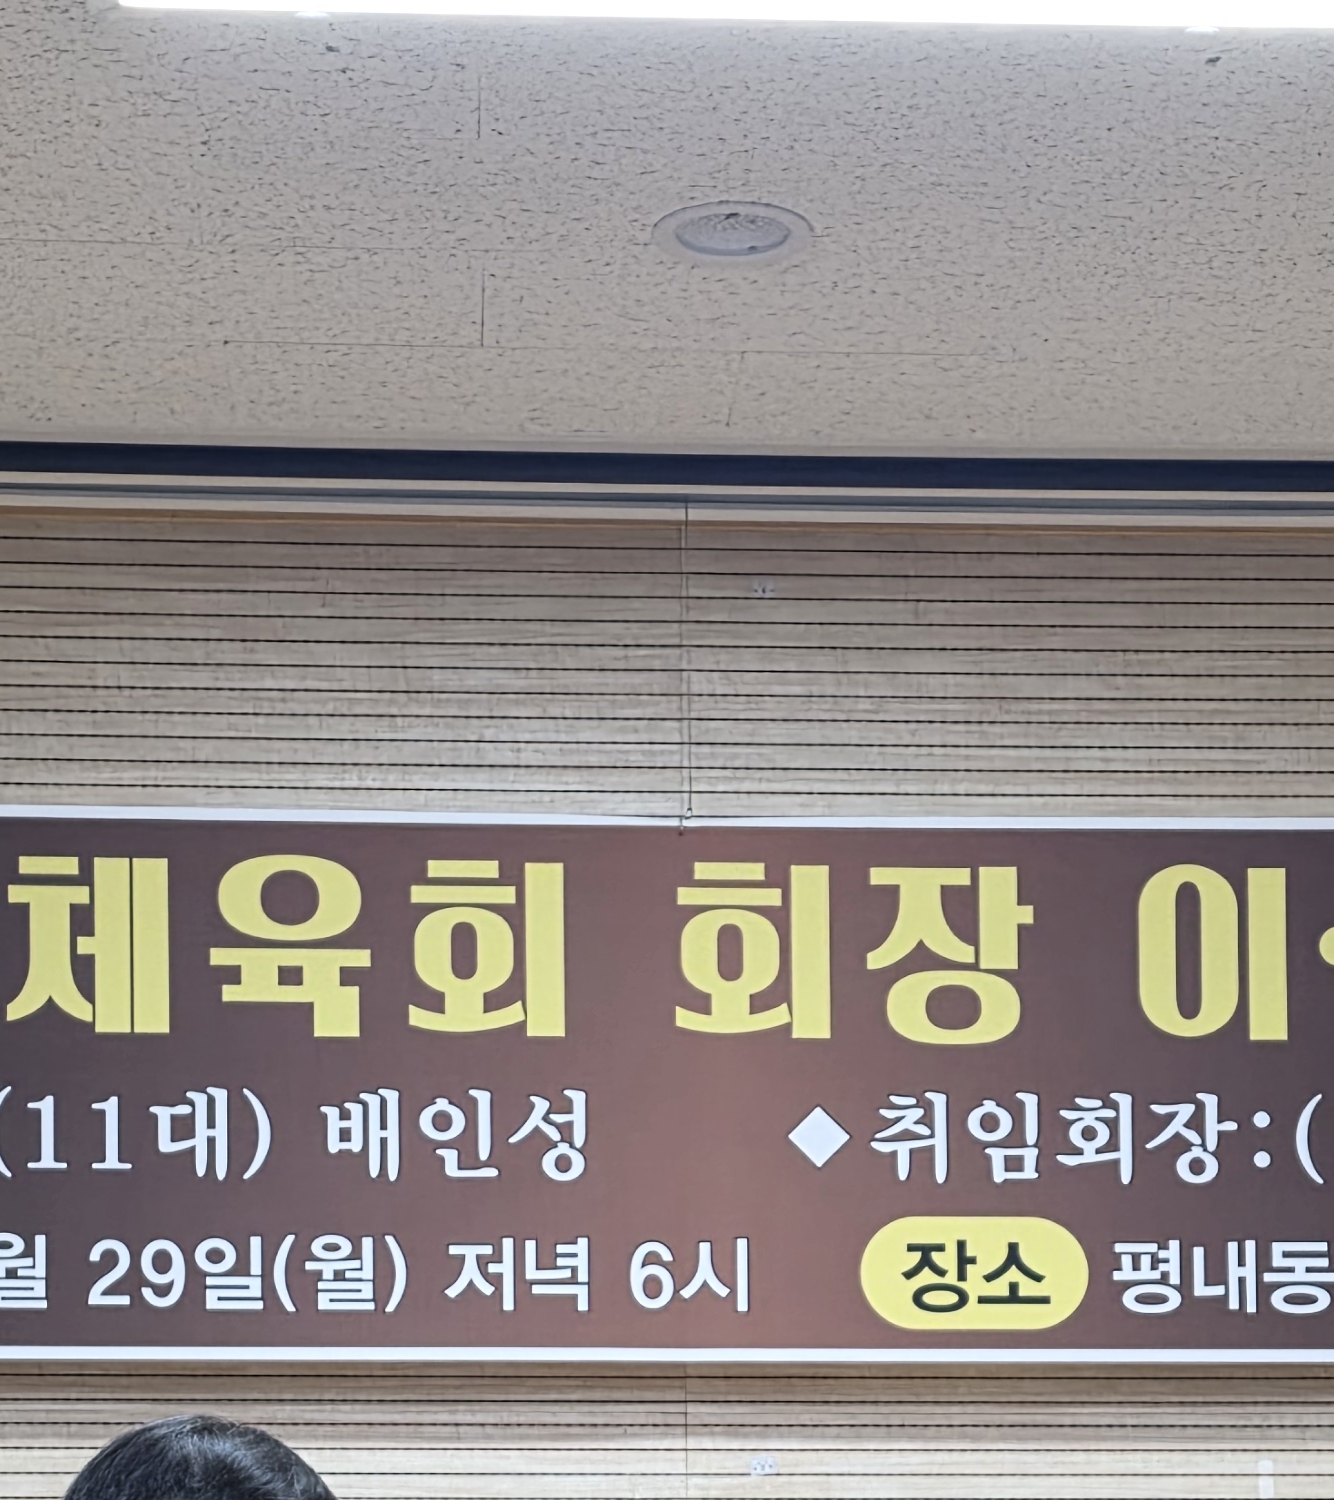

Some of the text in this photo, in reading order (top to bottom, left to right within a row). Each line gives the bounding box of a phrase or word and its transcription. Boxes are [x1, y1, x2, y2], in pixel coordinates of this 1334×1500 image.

[675, 861, 1034, 1045] 회장
[320, 1087, 587, 1182] 배인성
[87, 1233, 407, 1313] 29일(월)
[443, 1236, 590, 1312] 저녁
[629, 1236, 749, 1313] 6시
[901, 1239, 1051, 1313] 장소
